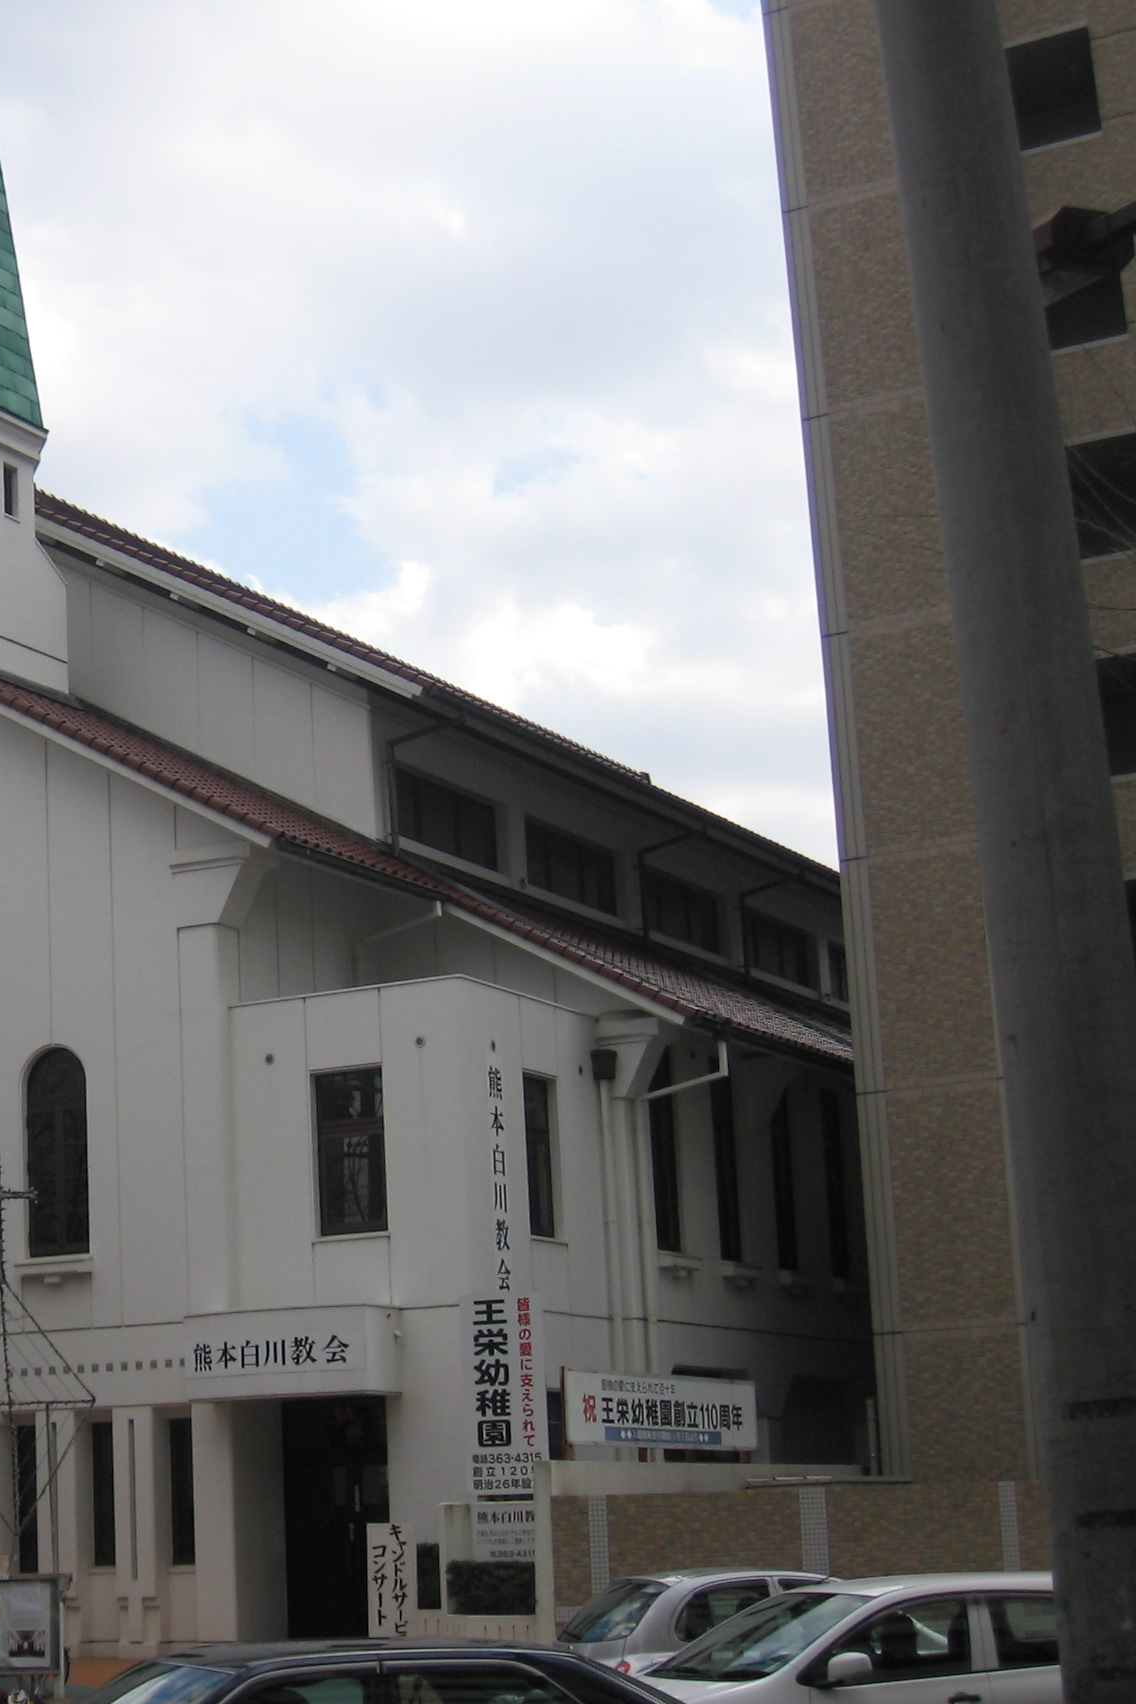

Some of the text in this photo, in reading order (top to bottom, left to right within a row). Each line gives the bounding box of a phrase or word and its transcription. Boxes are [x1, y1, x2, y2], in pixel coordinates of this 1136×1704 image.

[487, 1065, 511, 1292] 熊本白川教会
[193, 1334, 350, 1372] 熊本白川教会
[472, 1299, 512, 1447] 王栄幼稚園
[516, 1297, 535, 1447] 皆様の愛に支えられて
[582, 1394, 743, 1430] 祝 王栄幼稚園創立110周年
[473, 1478, 534, 1490] 明治26年設
[372, 1545, 388, 1626] コンサート
[389, 1524, 408, 1637] キャンドルサービ
